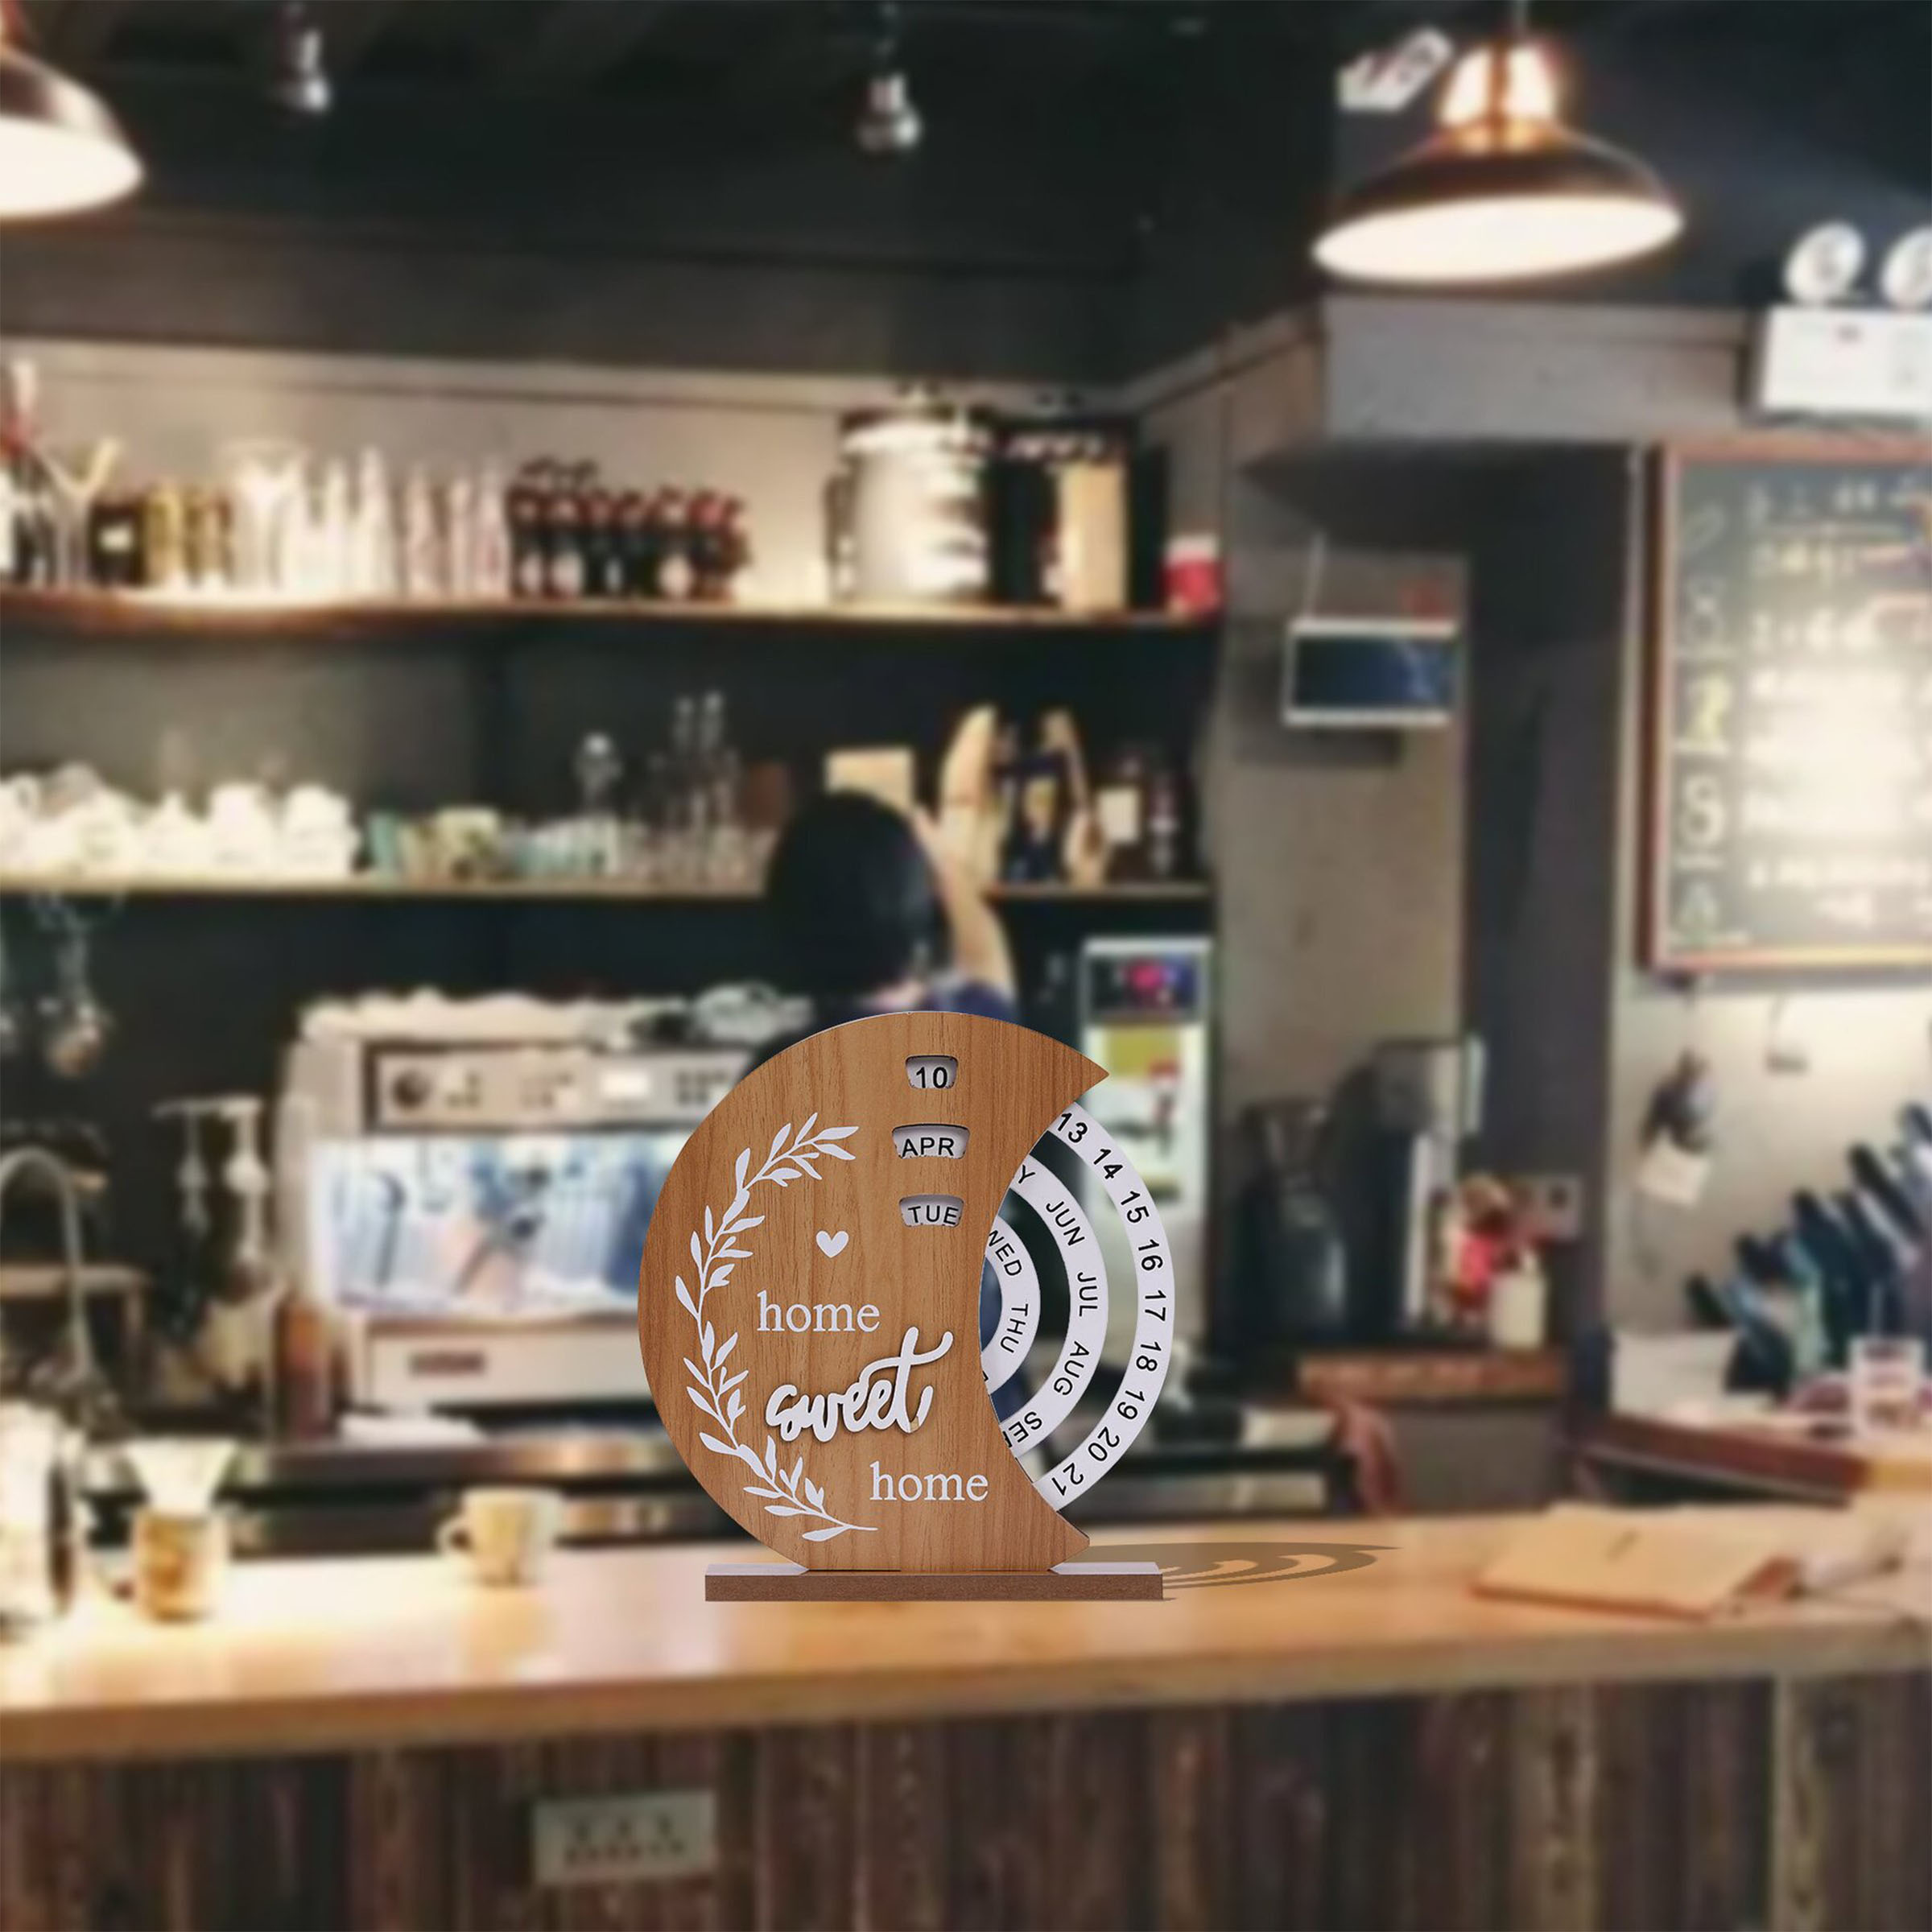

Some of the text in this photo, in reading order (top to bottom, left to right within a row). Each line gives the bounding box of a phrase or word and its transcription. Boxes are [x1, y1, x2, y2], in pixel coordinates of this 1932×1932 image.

[915, 1067, 948, 1088] 10
[902, 1137, 955, 1157] APR
[908, 1205, 959, 1225] TUE
[1046, 1201, 1086, 1246] JUN
[757, 1290, 881, 1333] home
[1051, 1113, 1167, 1496] 13 14 15 16 17 18 19 20 21
[1077, 1272, 1098, 1317] JUL
[1000, 1303, 1029, 1353] THU
[765, 1326, 955, 1443] sweet
[1053, 1340, 1090, 1396] AUG
[869, 1460, 989, 1502] home
